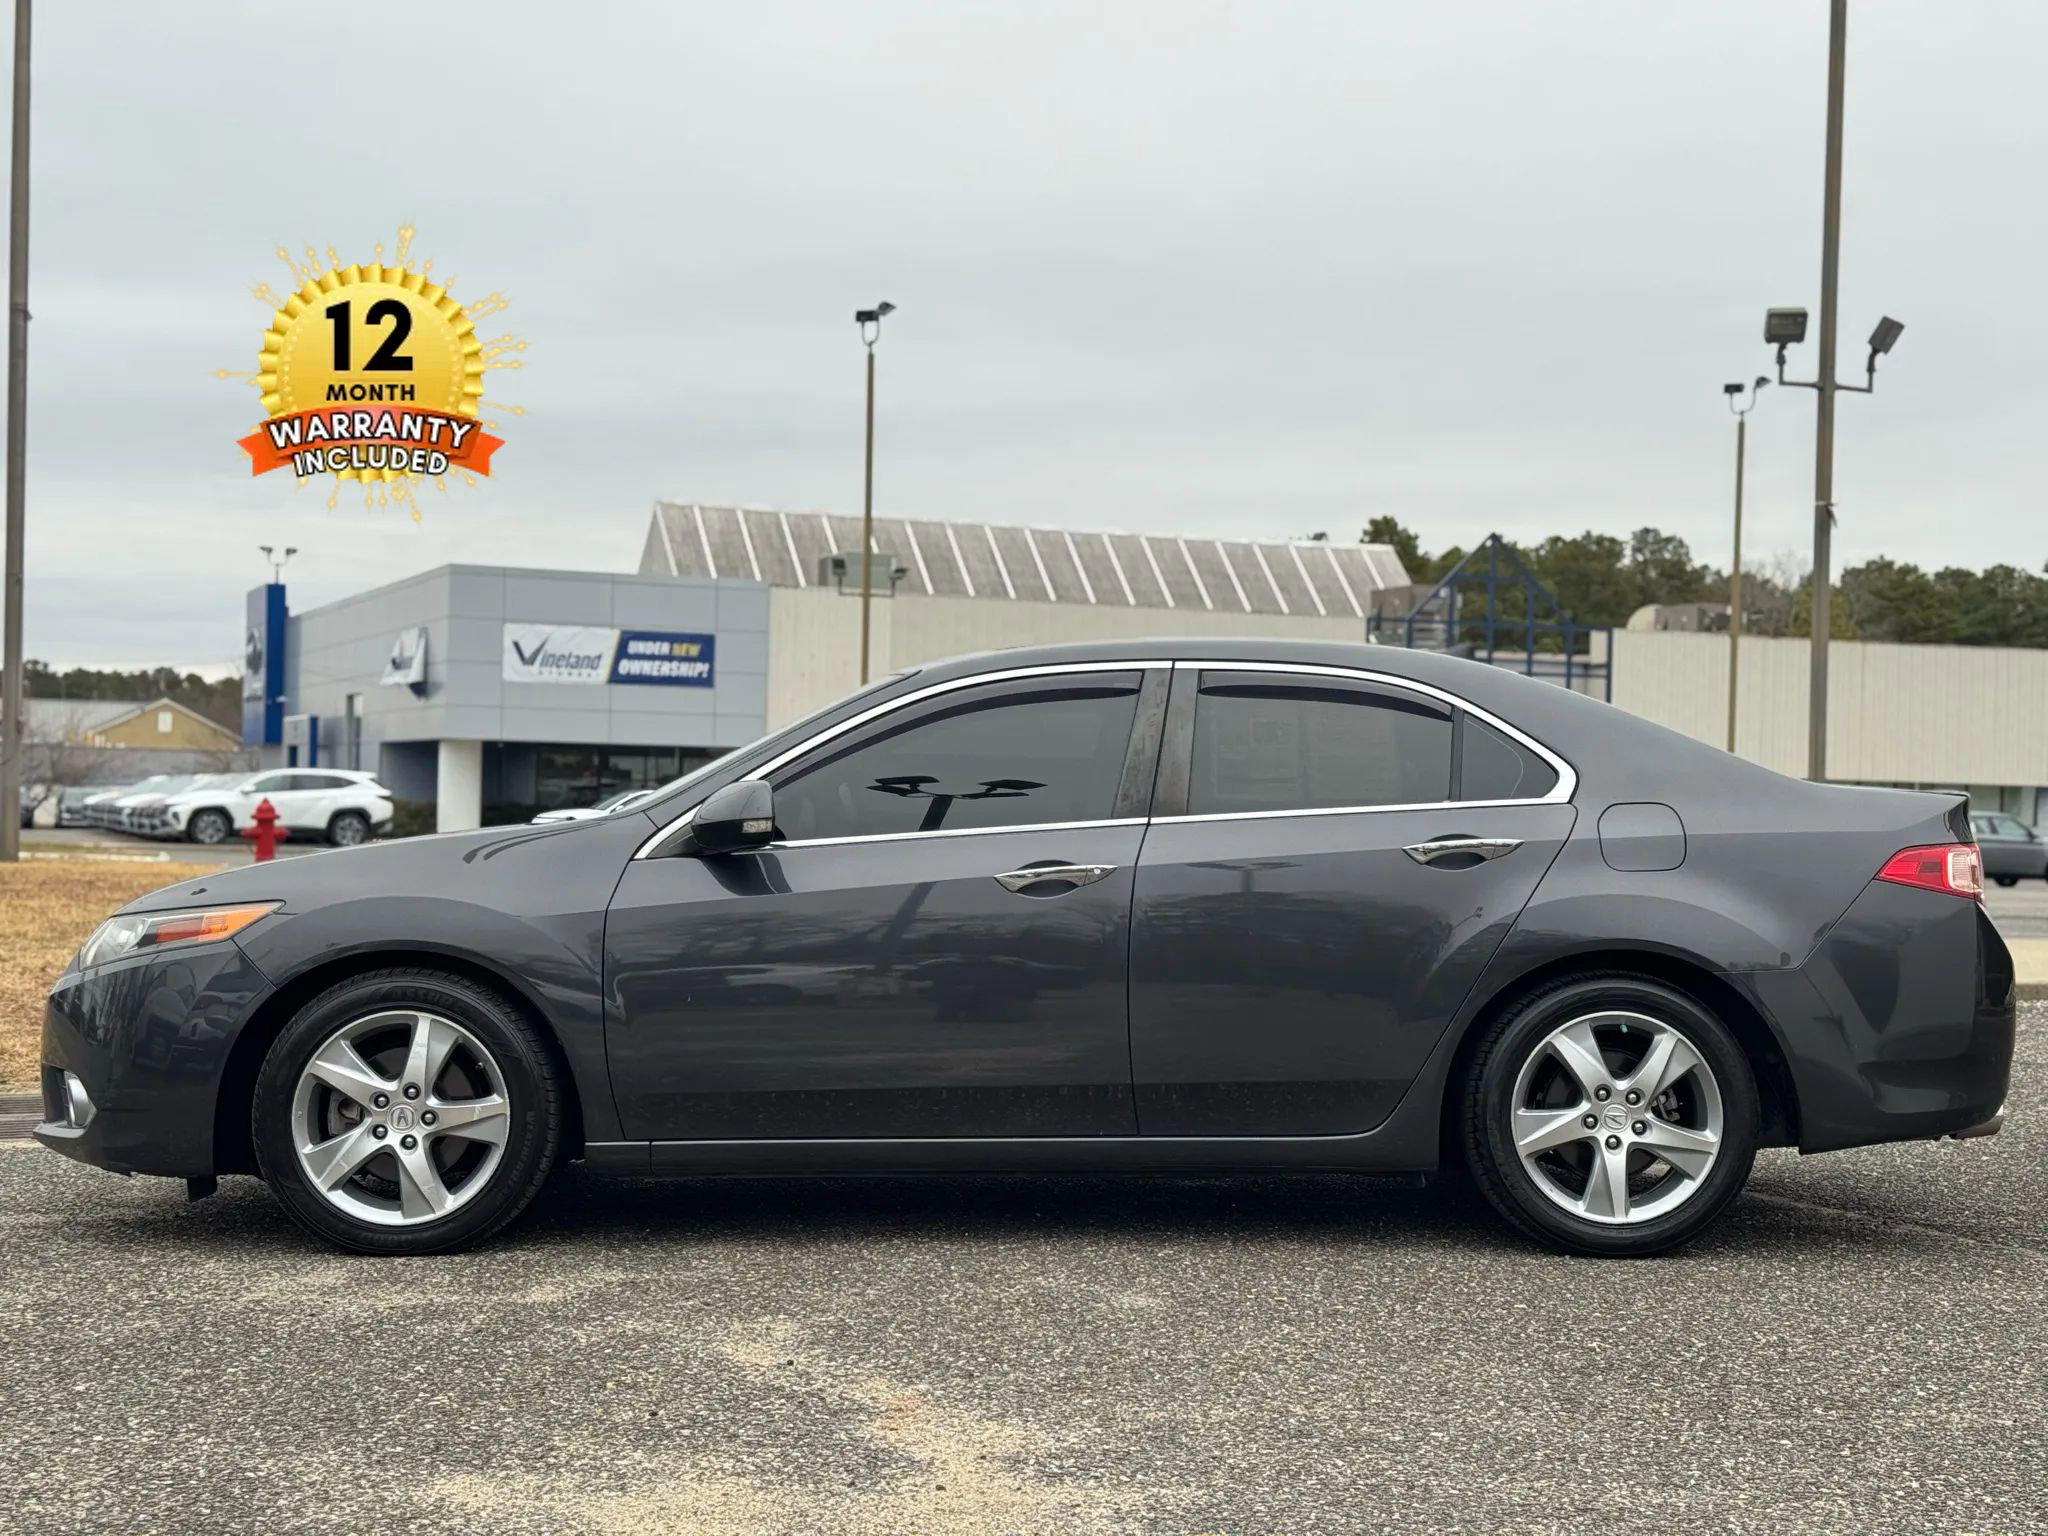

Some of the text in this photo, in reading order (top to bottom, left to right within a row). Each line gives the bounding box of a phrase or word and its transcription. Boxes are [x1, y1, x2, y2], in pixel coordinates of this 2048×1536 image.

[512, 634, 603, 670] Vineland
[627, 640, 701, 657] UNDER NEW
[618, 659, 710, 678] OWNERSHIP!
